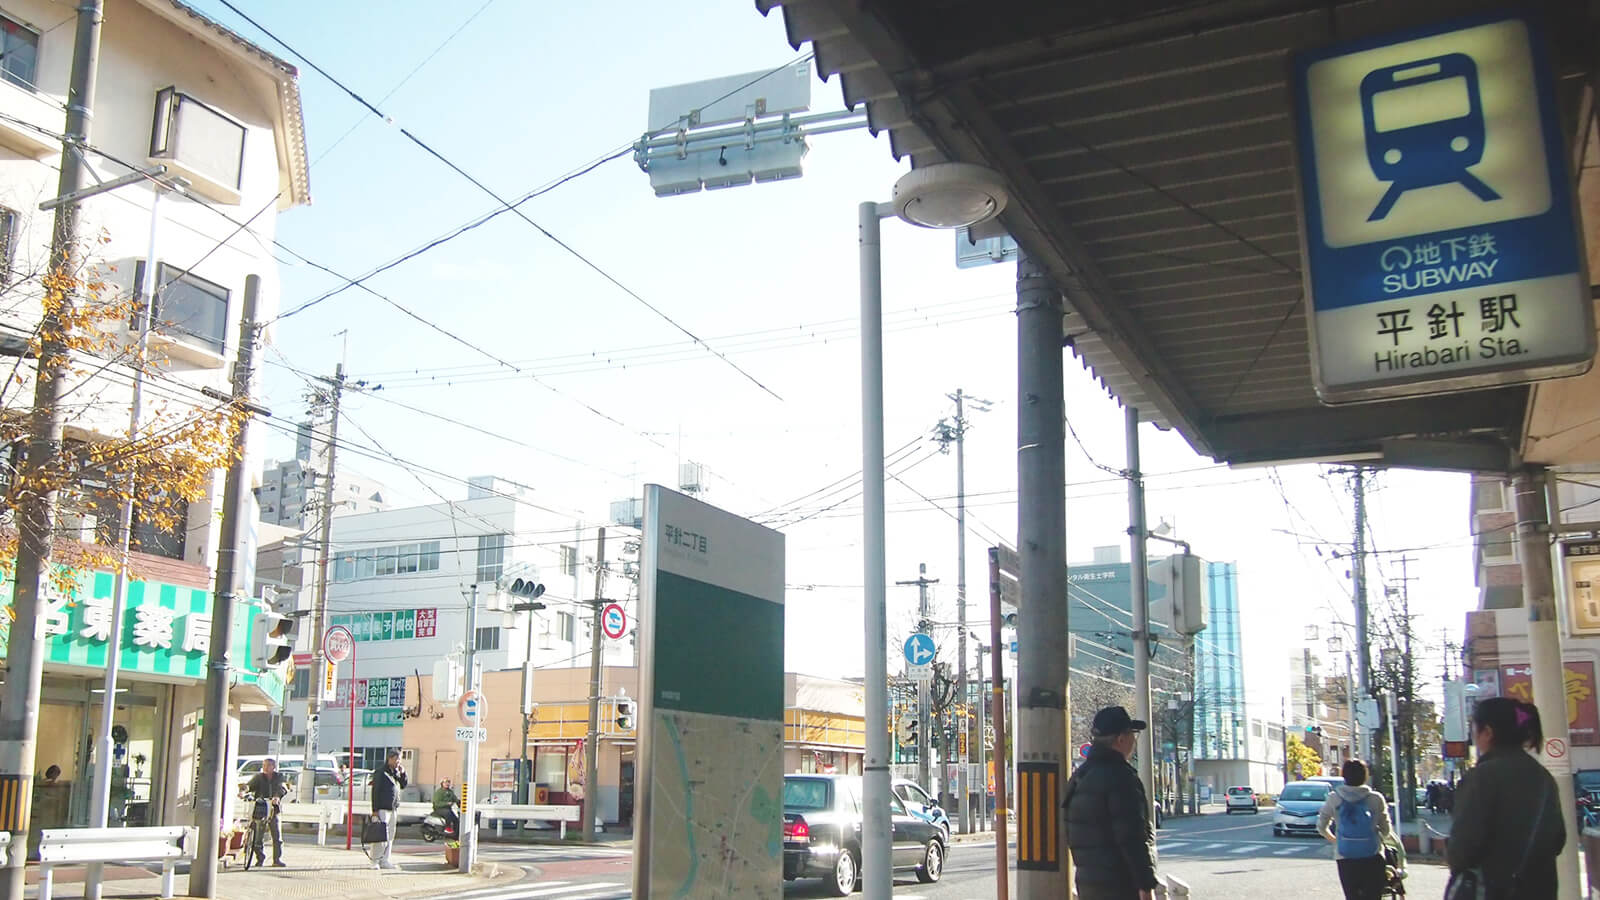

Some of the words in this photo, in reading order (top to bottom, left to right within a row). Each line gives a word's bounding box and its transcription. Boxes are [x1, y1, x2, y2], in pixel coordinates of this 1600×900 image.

[1413, 232, 1498, 266] 地下鉄
[1382, 258, 1499, 293] SUBWAY
[1376, 293, 1521, 346] 平針駅
[1374, 340, 1471, 373] Hirabari
[1479, 336, 1529, 361] Sta.
[664, 523, 707, 554] 平針二丁目
[457, 729, 486, 740] マイクロK
